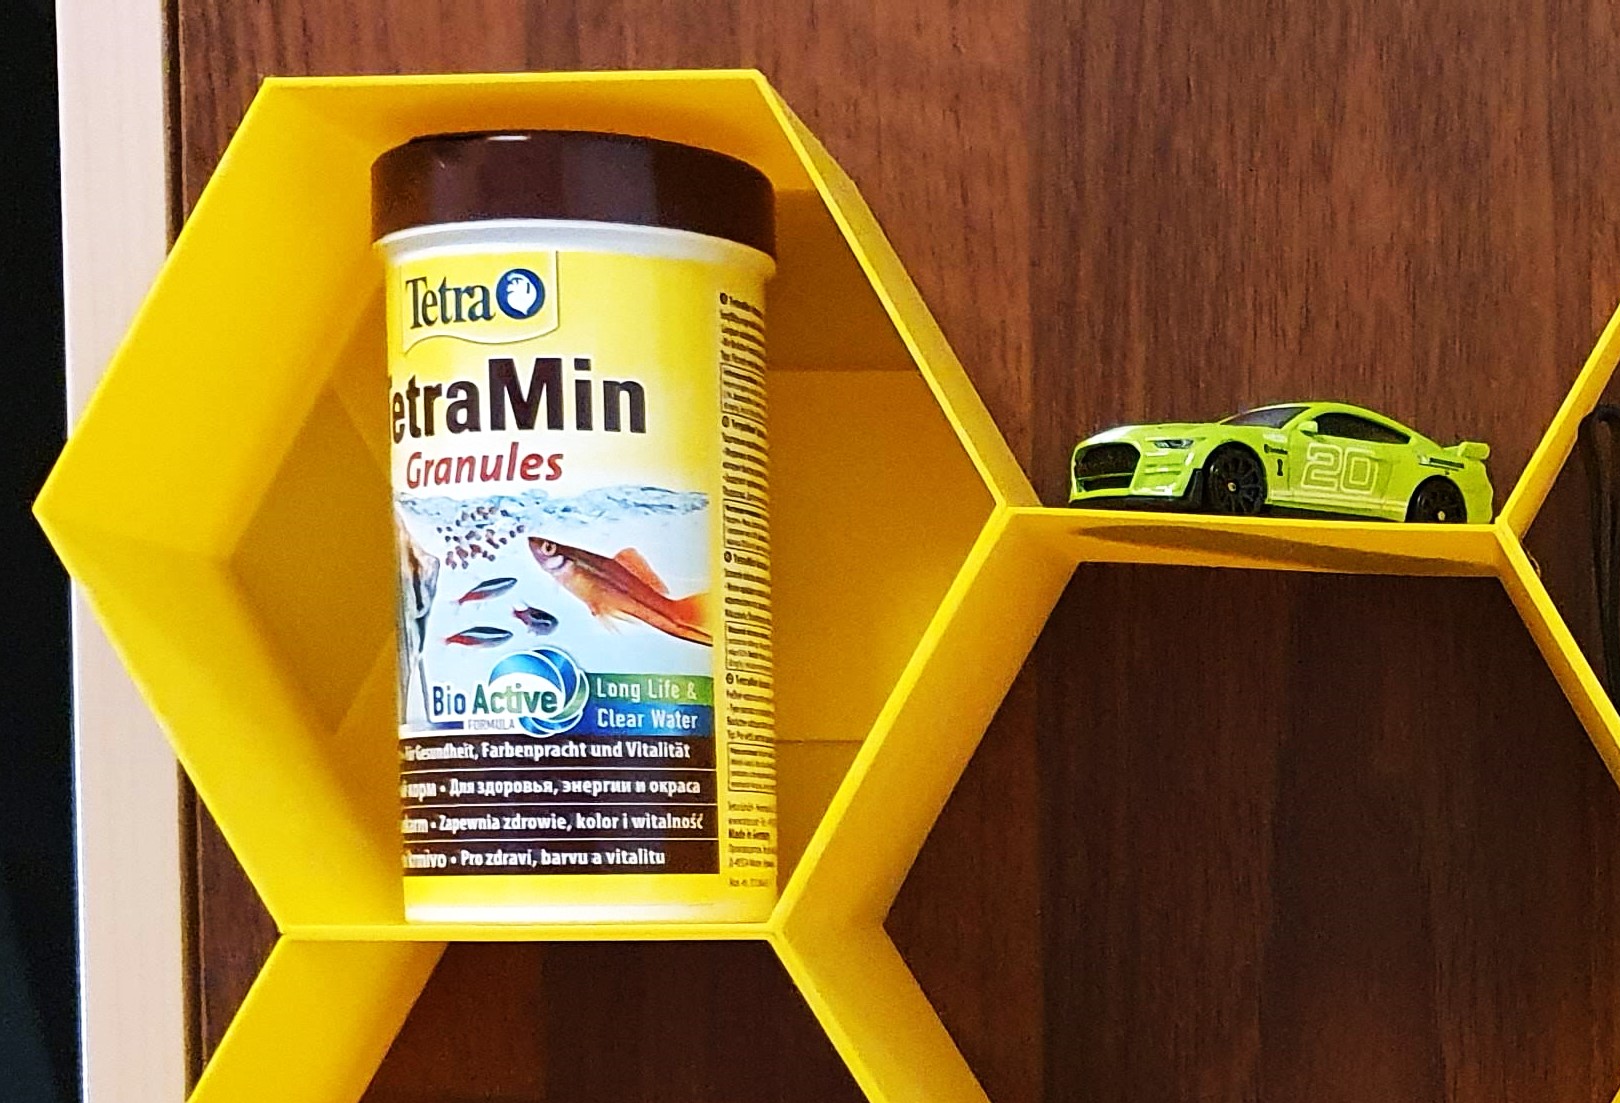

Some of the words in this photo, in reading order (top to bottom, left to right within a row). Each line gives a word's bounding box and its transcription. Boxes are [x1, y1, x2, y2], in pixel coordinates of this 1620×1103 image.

[405, 276, 495, 330] Tetra
[388, 357, 647, 444] etraMin
[406, 441, 564, 489] Granules
[1301, 442, 1379, 495] 20
[433, 684, 466, 716] Bio
[471, 683, 558, 715] Active
[596, 677, 641, 702] Long
[648, 678, 682, 700] Life
[687, 682, 699, 700] &
[467, 717, 515, 731] FORMULA
[596, 705, 644, 729] Clear
[651, 708, 699, 730] Water
[481, 741, 587, 762] Farbenpracht
[590, 741, 623, 758] und
[625, 741, 691, 758] Vitalität
[476, 780, 560, 797] здоровья,
[561, 780, 632, 797] энергии
[635, 780, 646, 793] и
[649, 780, 701, 798] окраса
[439, 814, 500, 834] Zapewnia
[502, 812, 573, 832] zdrowie,
[575, 811, 620, 830] kolor
[622, 812, 629, 830] i
[460, 849, 484, 867] Pro
[540, 848, 589, 866] barvu
[591, 851, 603, 866] a
[605, 848, 666, 866] vitalitu
